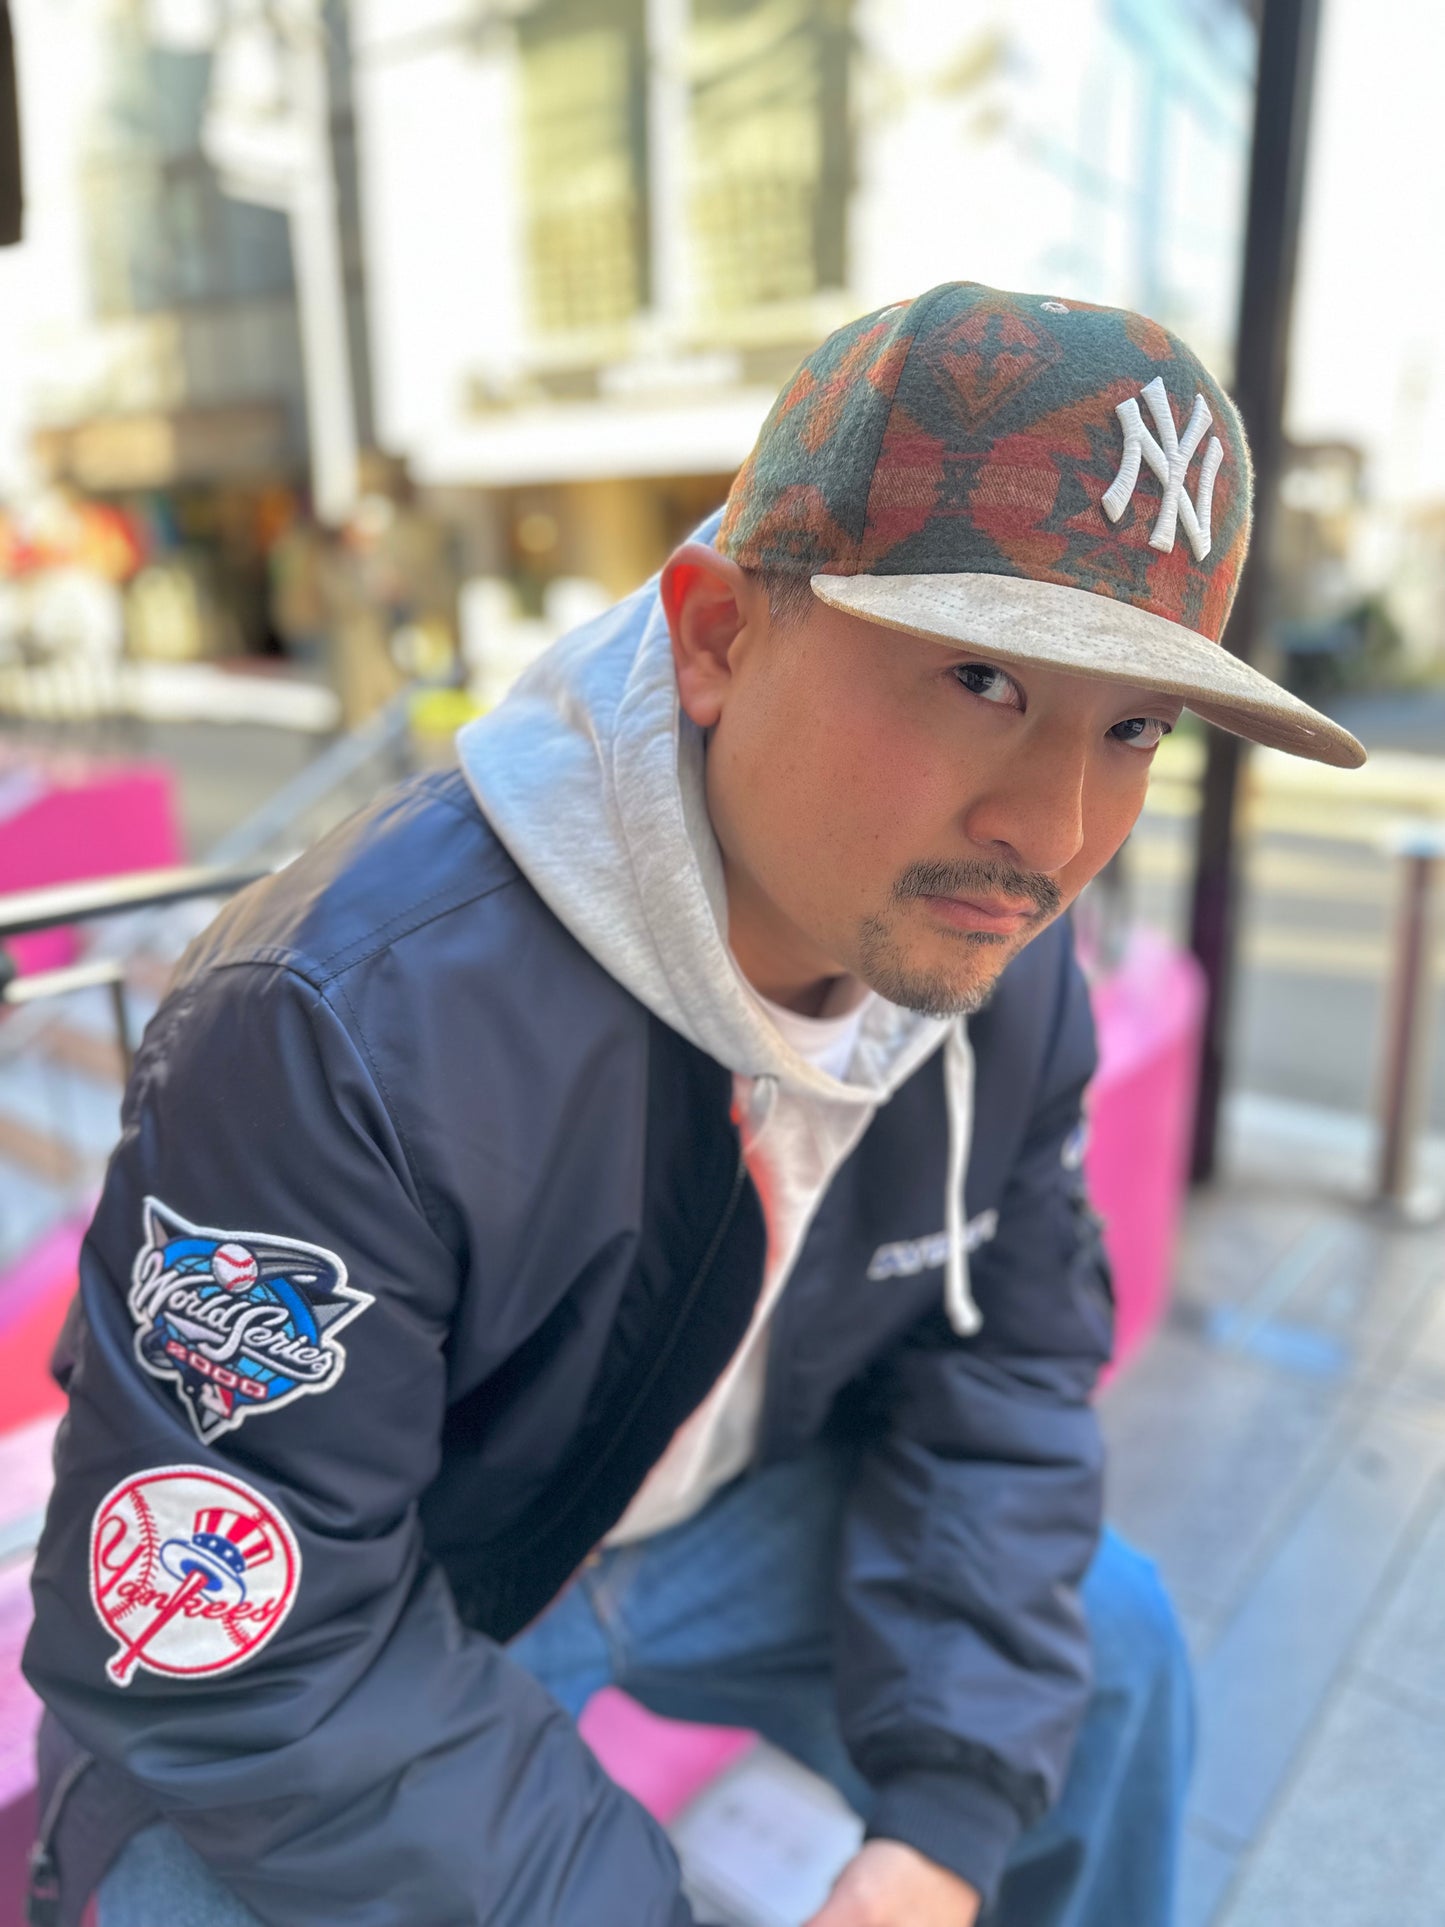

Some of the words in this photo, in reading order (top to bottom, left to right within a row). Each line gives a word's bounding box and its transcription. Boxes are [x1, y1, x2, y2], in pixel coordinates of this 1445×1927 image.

[1101, 376, 1224, 561] NY
[136, 1251, 251, 1332] World
[197, 1305, 333, 1381] Series
[166, 1340, 268, 1399] 2000
[100, 1515, 276, 1622] Yankees
